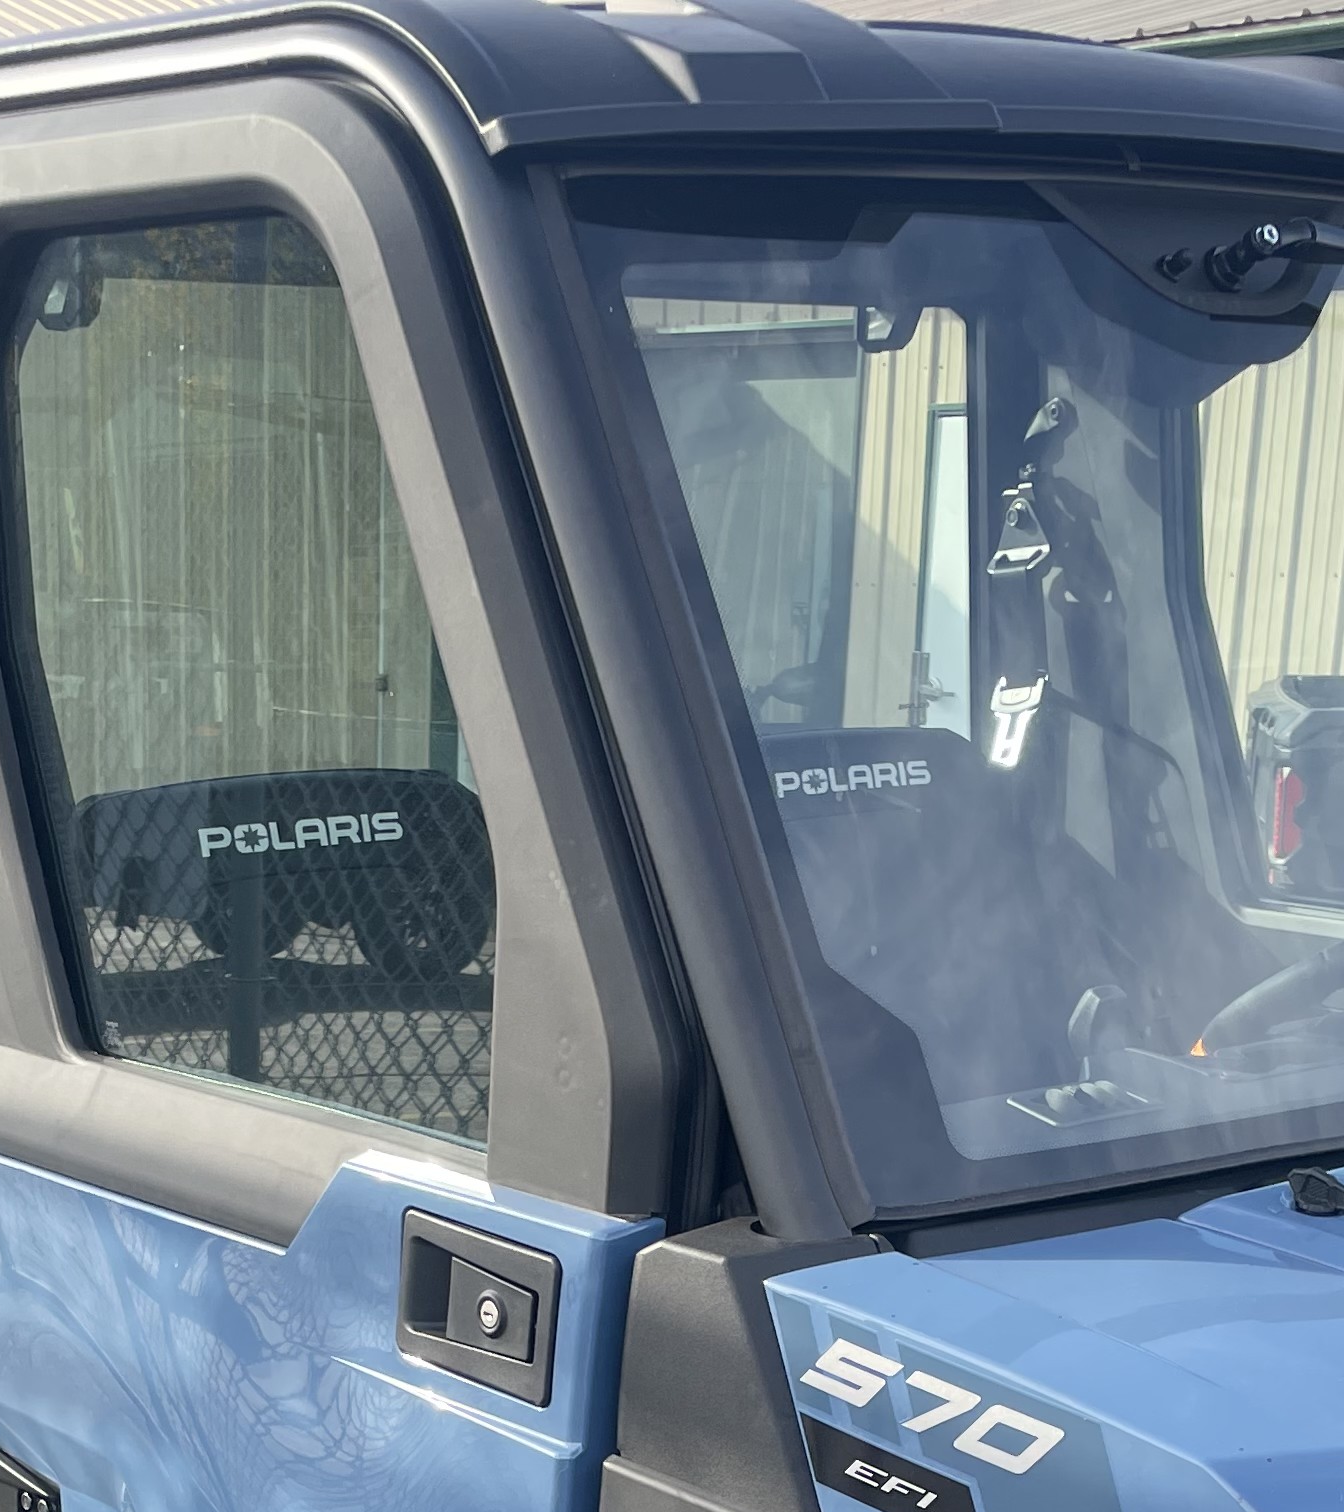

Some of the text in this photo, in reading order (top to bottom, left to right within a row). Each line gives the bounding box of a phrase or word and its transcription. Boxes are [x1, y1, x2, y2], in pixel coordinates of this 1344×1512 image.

[774, 759, 933, 799] POLARIS
[198, 810, 404, 859] POLARIS
[799, 1337, 1065, 1475] 570
[844, 1459, 938, 1509] EFI
